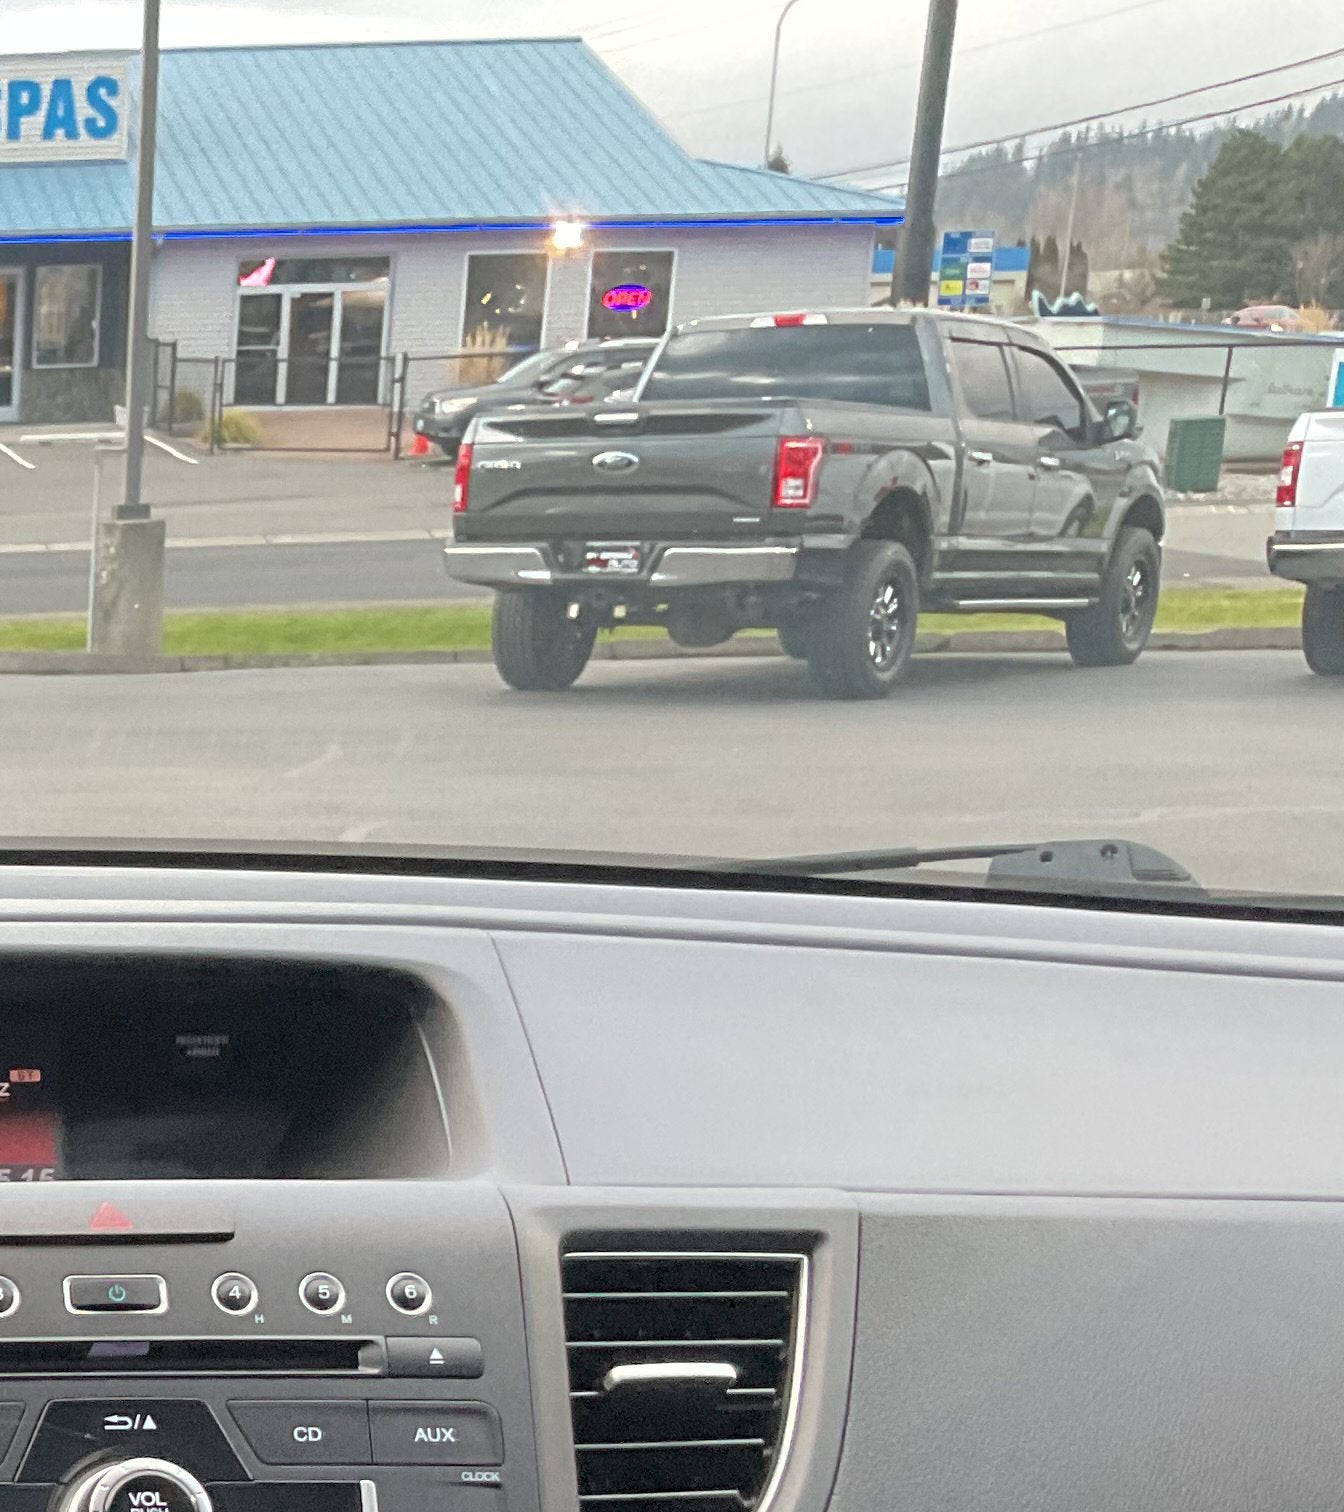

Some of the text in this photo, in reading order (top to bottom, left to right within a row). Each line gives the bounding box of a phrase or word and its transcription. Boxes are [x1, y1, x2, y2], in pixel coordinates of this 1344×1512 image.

[228, 1285, 241, 1299] 4
[318, 1285, 330, 1300] 5
[404, 1284, 417, 1299] 6
[254, 1314, 264, 1325] H
[341, 1314, 353, 1325] M
[428, 1315, 438, 1326] R
[292, 1426, 322, 1442] CD
[413, 1426, 455, 1442] AUX
[460, 1471, 501, 1482] CLOCK
[128, 1491, 168, 1507] VOL
